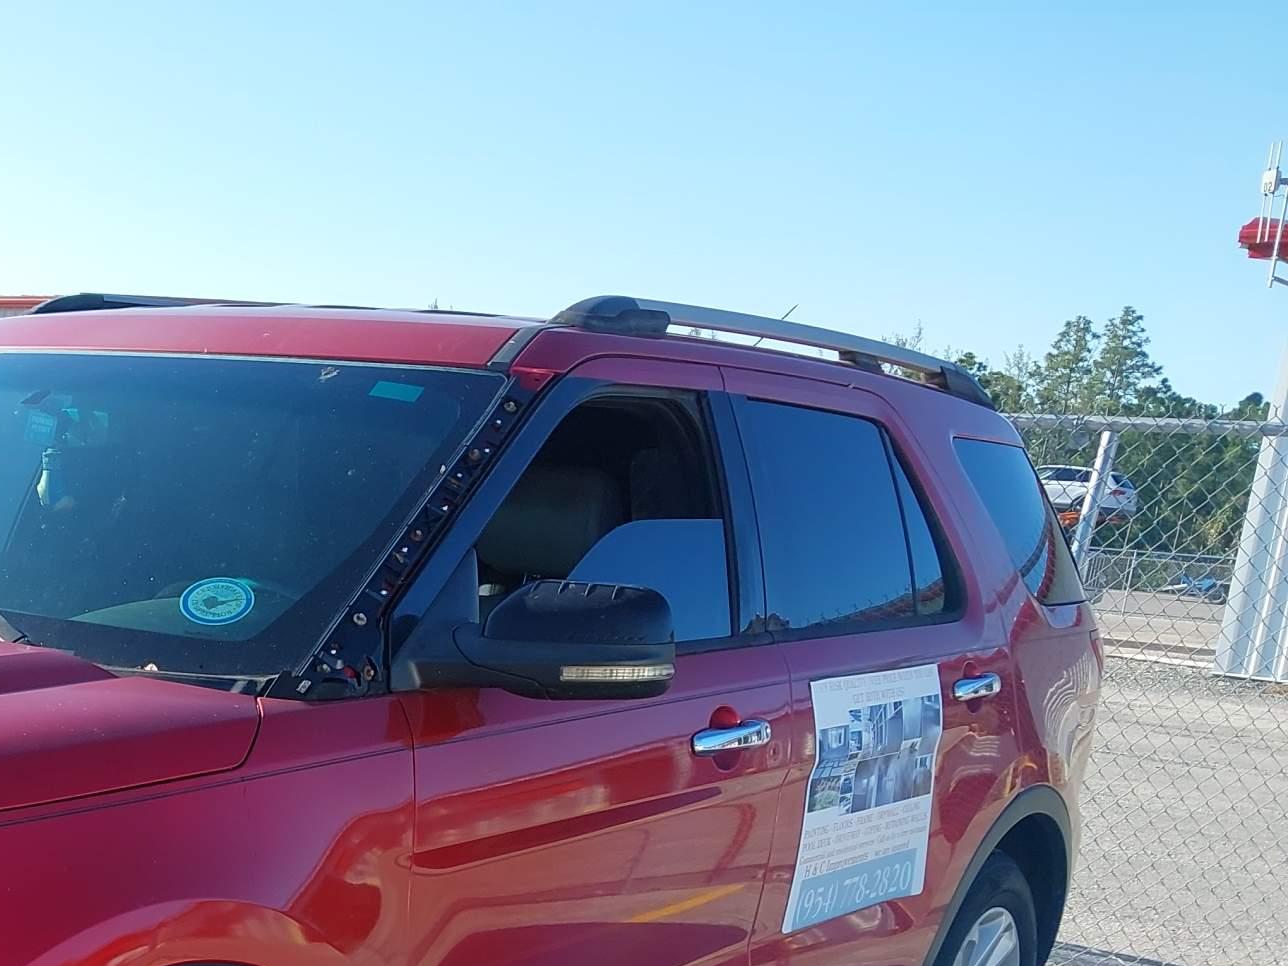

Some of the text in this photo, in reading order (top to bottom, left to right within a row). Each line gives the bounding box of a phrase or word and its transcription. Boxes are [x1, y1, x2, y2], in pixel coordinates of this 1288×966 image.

[804, 864, 811, 878] H
[796, 861, 912, 923] (954) 778-2820
